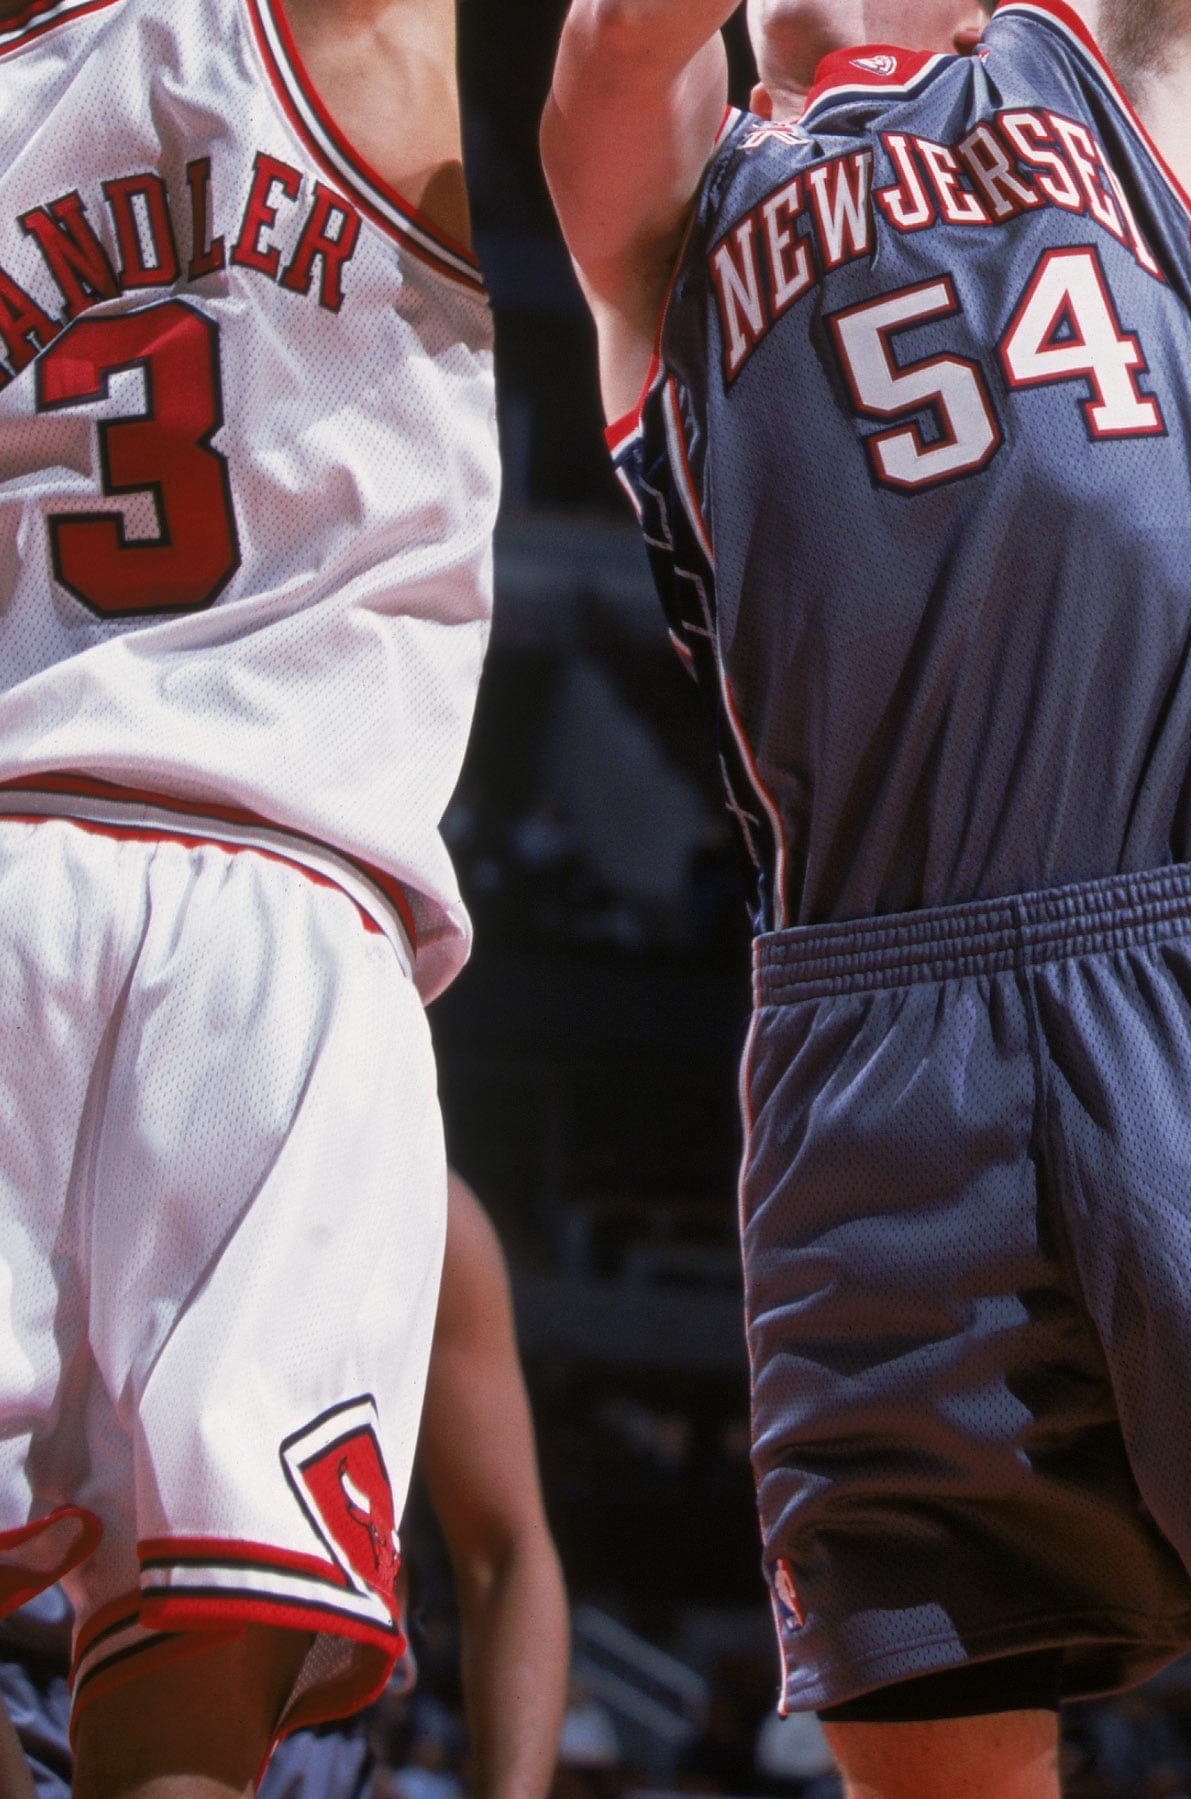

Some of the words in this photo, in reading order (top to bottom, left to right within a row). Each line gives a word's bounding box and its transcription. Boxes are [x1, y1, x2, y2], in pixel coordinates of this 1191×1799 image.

[0, 150, 363, 392] ANDLER
[707, 145, 876, 390] NEW
[822, 242, 1168, 496] 54
[35, 297, 242, 618] 3
